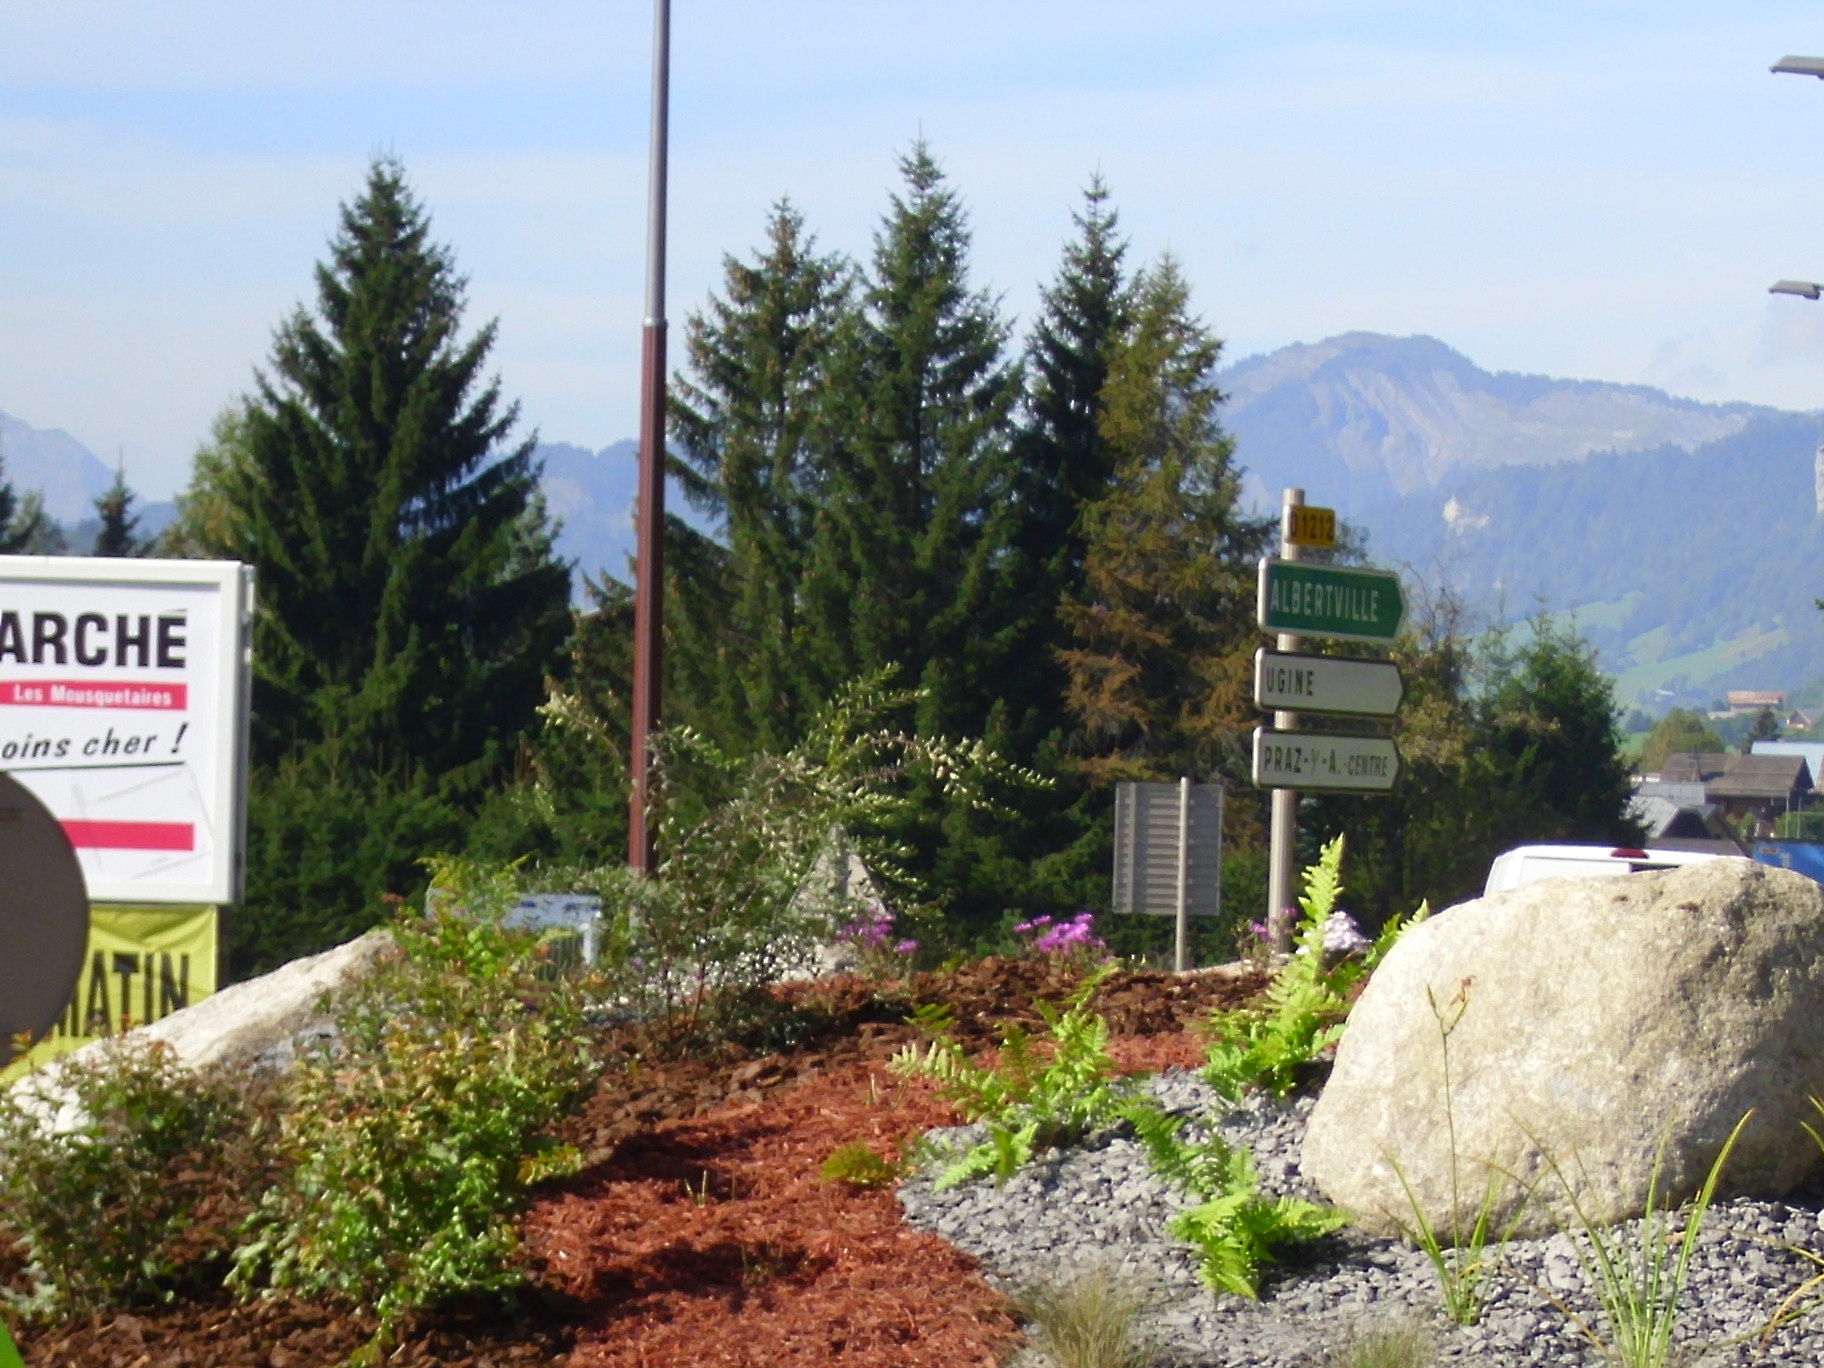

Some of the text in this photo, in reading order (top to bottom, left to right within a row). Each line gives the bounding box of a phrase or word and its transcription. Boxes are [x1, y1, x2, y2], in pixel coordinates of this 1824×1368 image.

[1302, 513, 1334, 541] 1212
[1271, 578, 1379, 622] ALBERTVILLE
[14, 683, 172, 706] Les Mousquetaires
[1266, 667, 1314, 696] UGINE
[1, 721, 189, 759] oins cher !
